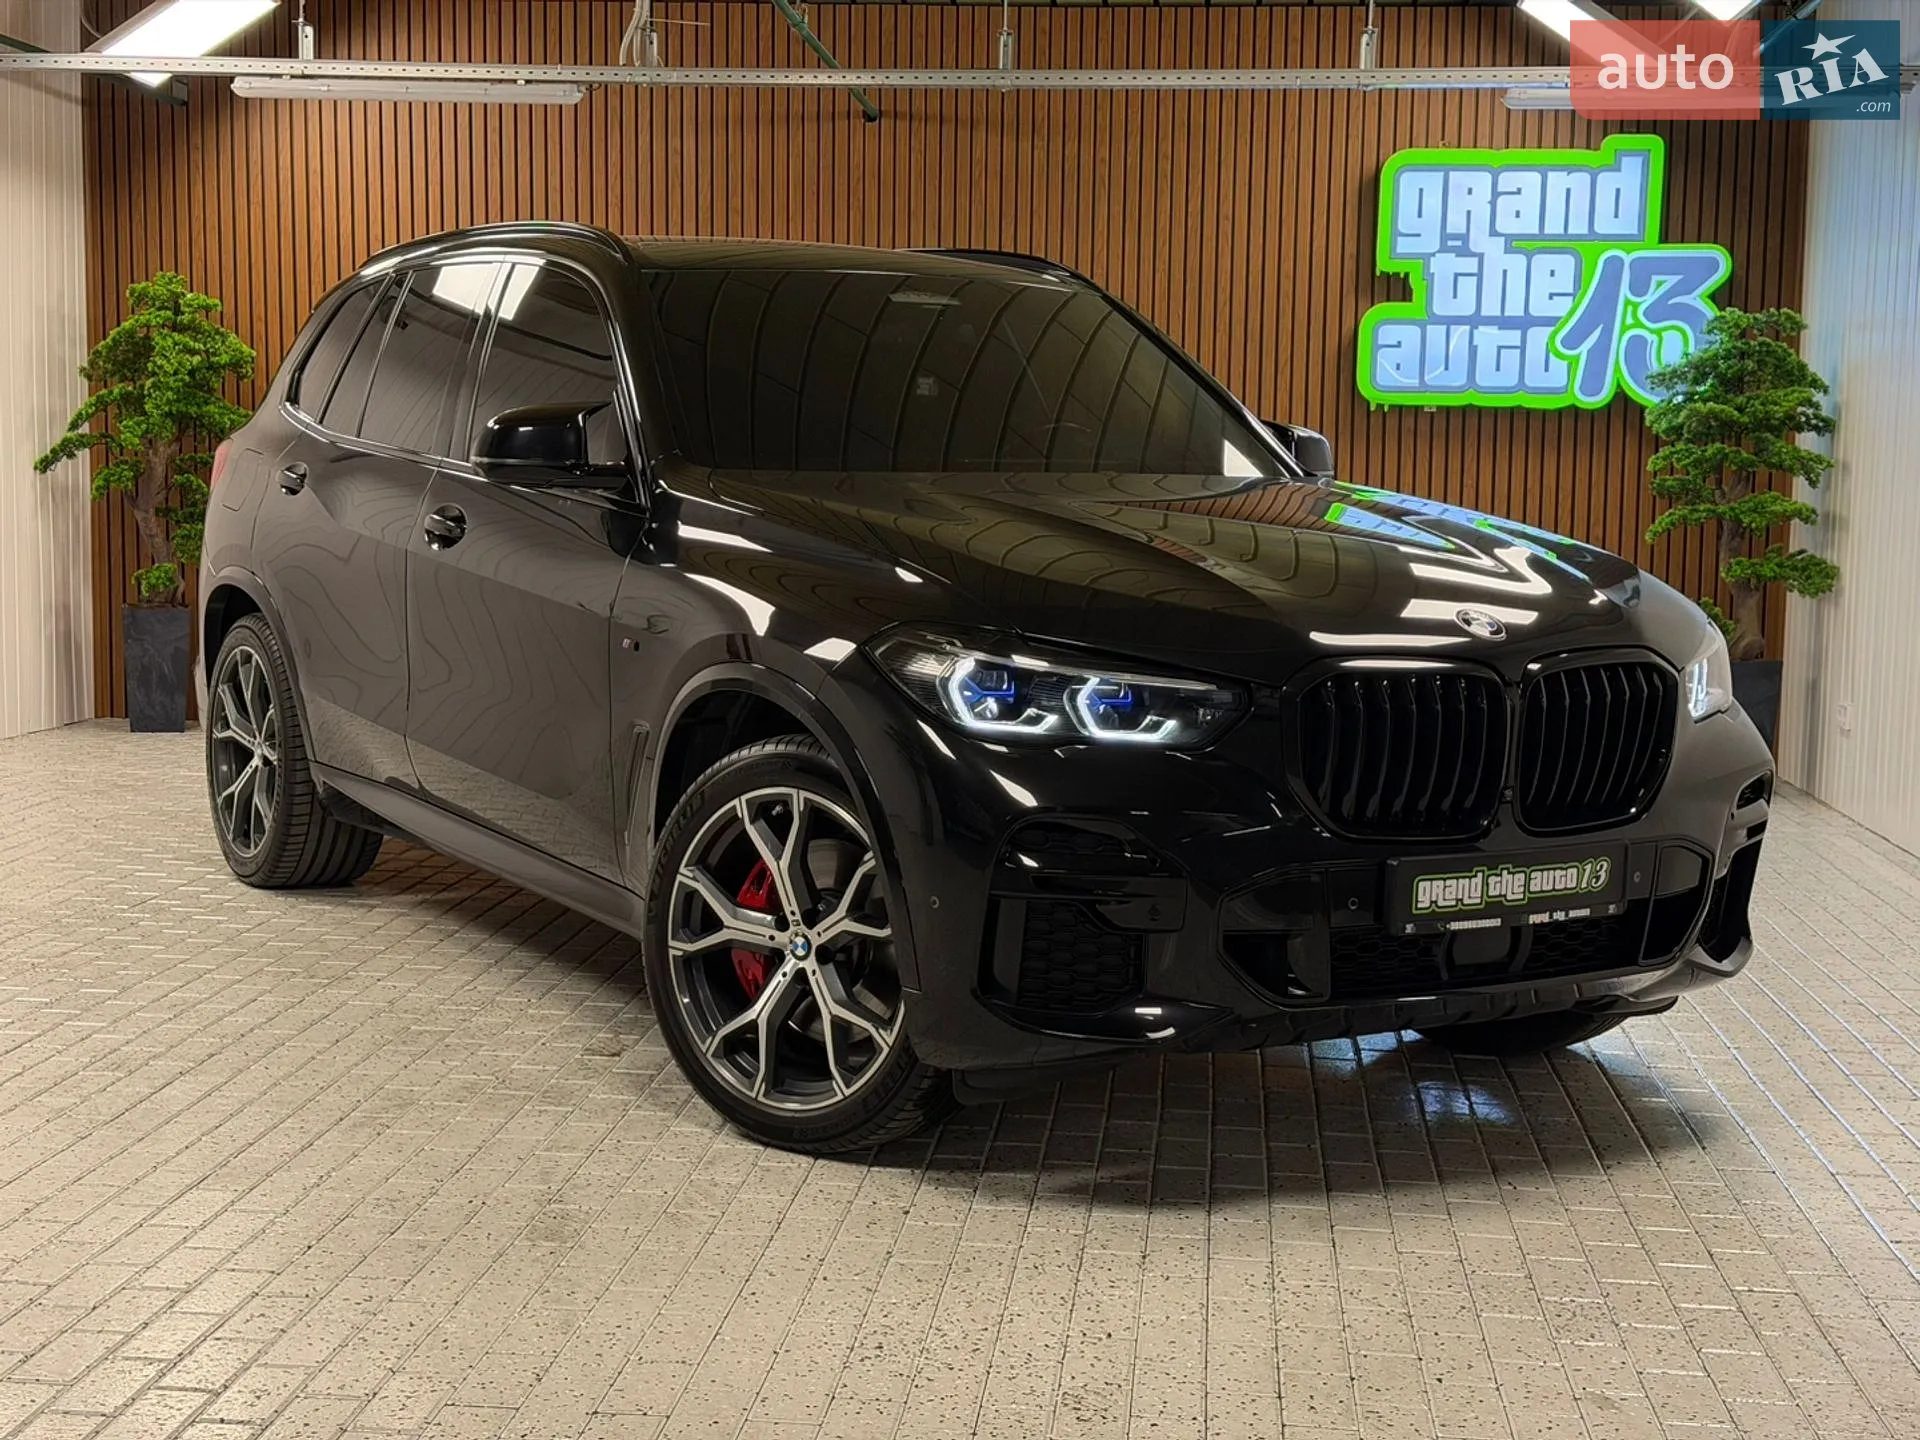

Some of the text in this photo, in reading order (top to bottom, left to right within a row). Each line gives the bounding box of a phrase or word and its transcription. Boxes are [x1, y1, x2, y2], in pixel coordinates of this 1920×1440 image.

[1396, 155, 1645, 253] grand
[1376, 249, 1724, 402] auto 13
[1430, 250, 1577, 318] the
[1417, 872, 1482, 908] grand
[1488, 866, 1525, 899] the
